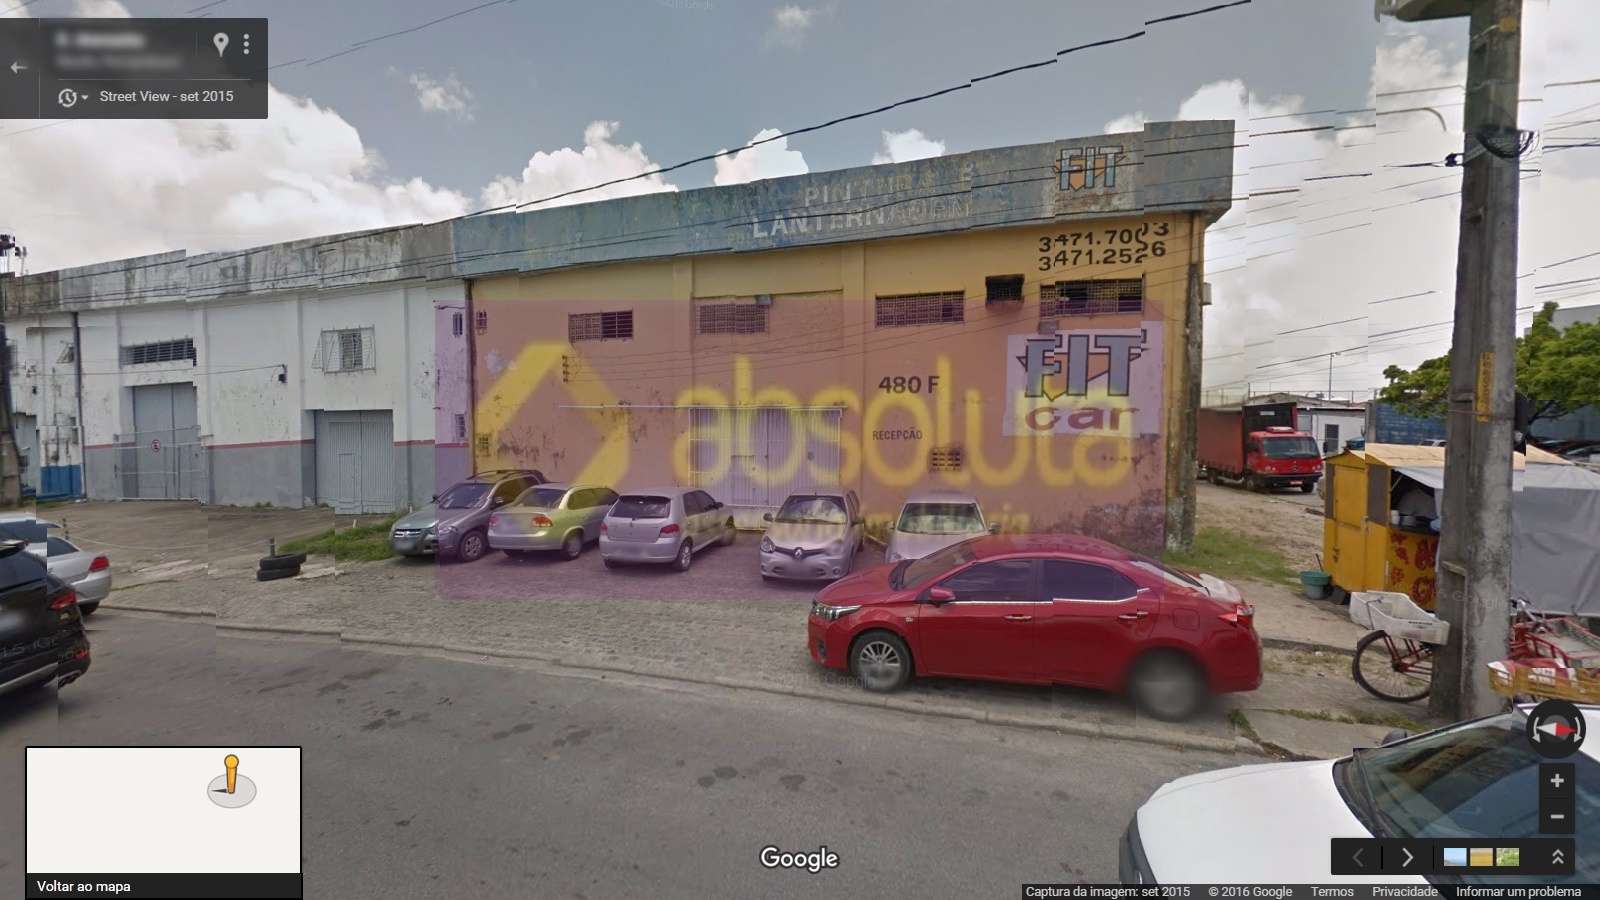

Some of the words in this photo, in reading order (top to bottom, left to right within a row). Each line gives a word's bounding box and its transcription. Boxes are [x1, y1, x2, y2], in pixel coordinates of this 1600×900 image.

[1060, 144, 1124, 191] FIT
[1038, 240, 1167, 271] 3471.2526
[1024, 329, 1147, 398] FIT
[878, 375, 922, 394] 480
[928, 375, 941, 394] F
[1024, 405, 1141, 432] car
[871, 426, 923, 442] RECEPÇÃO
